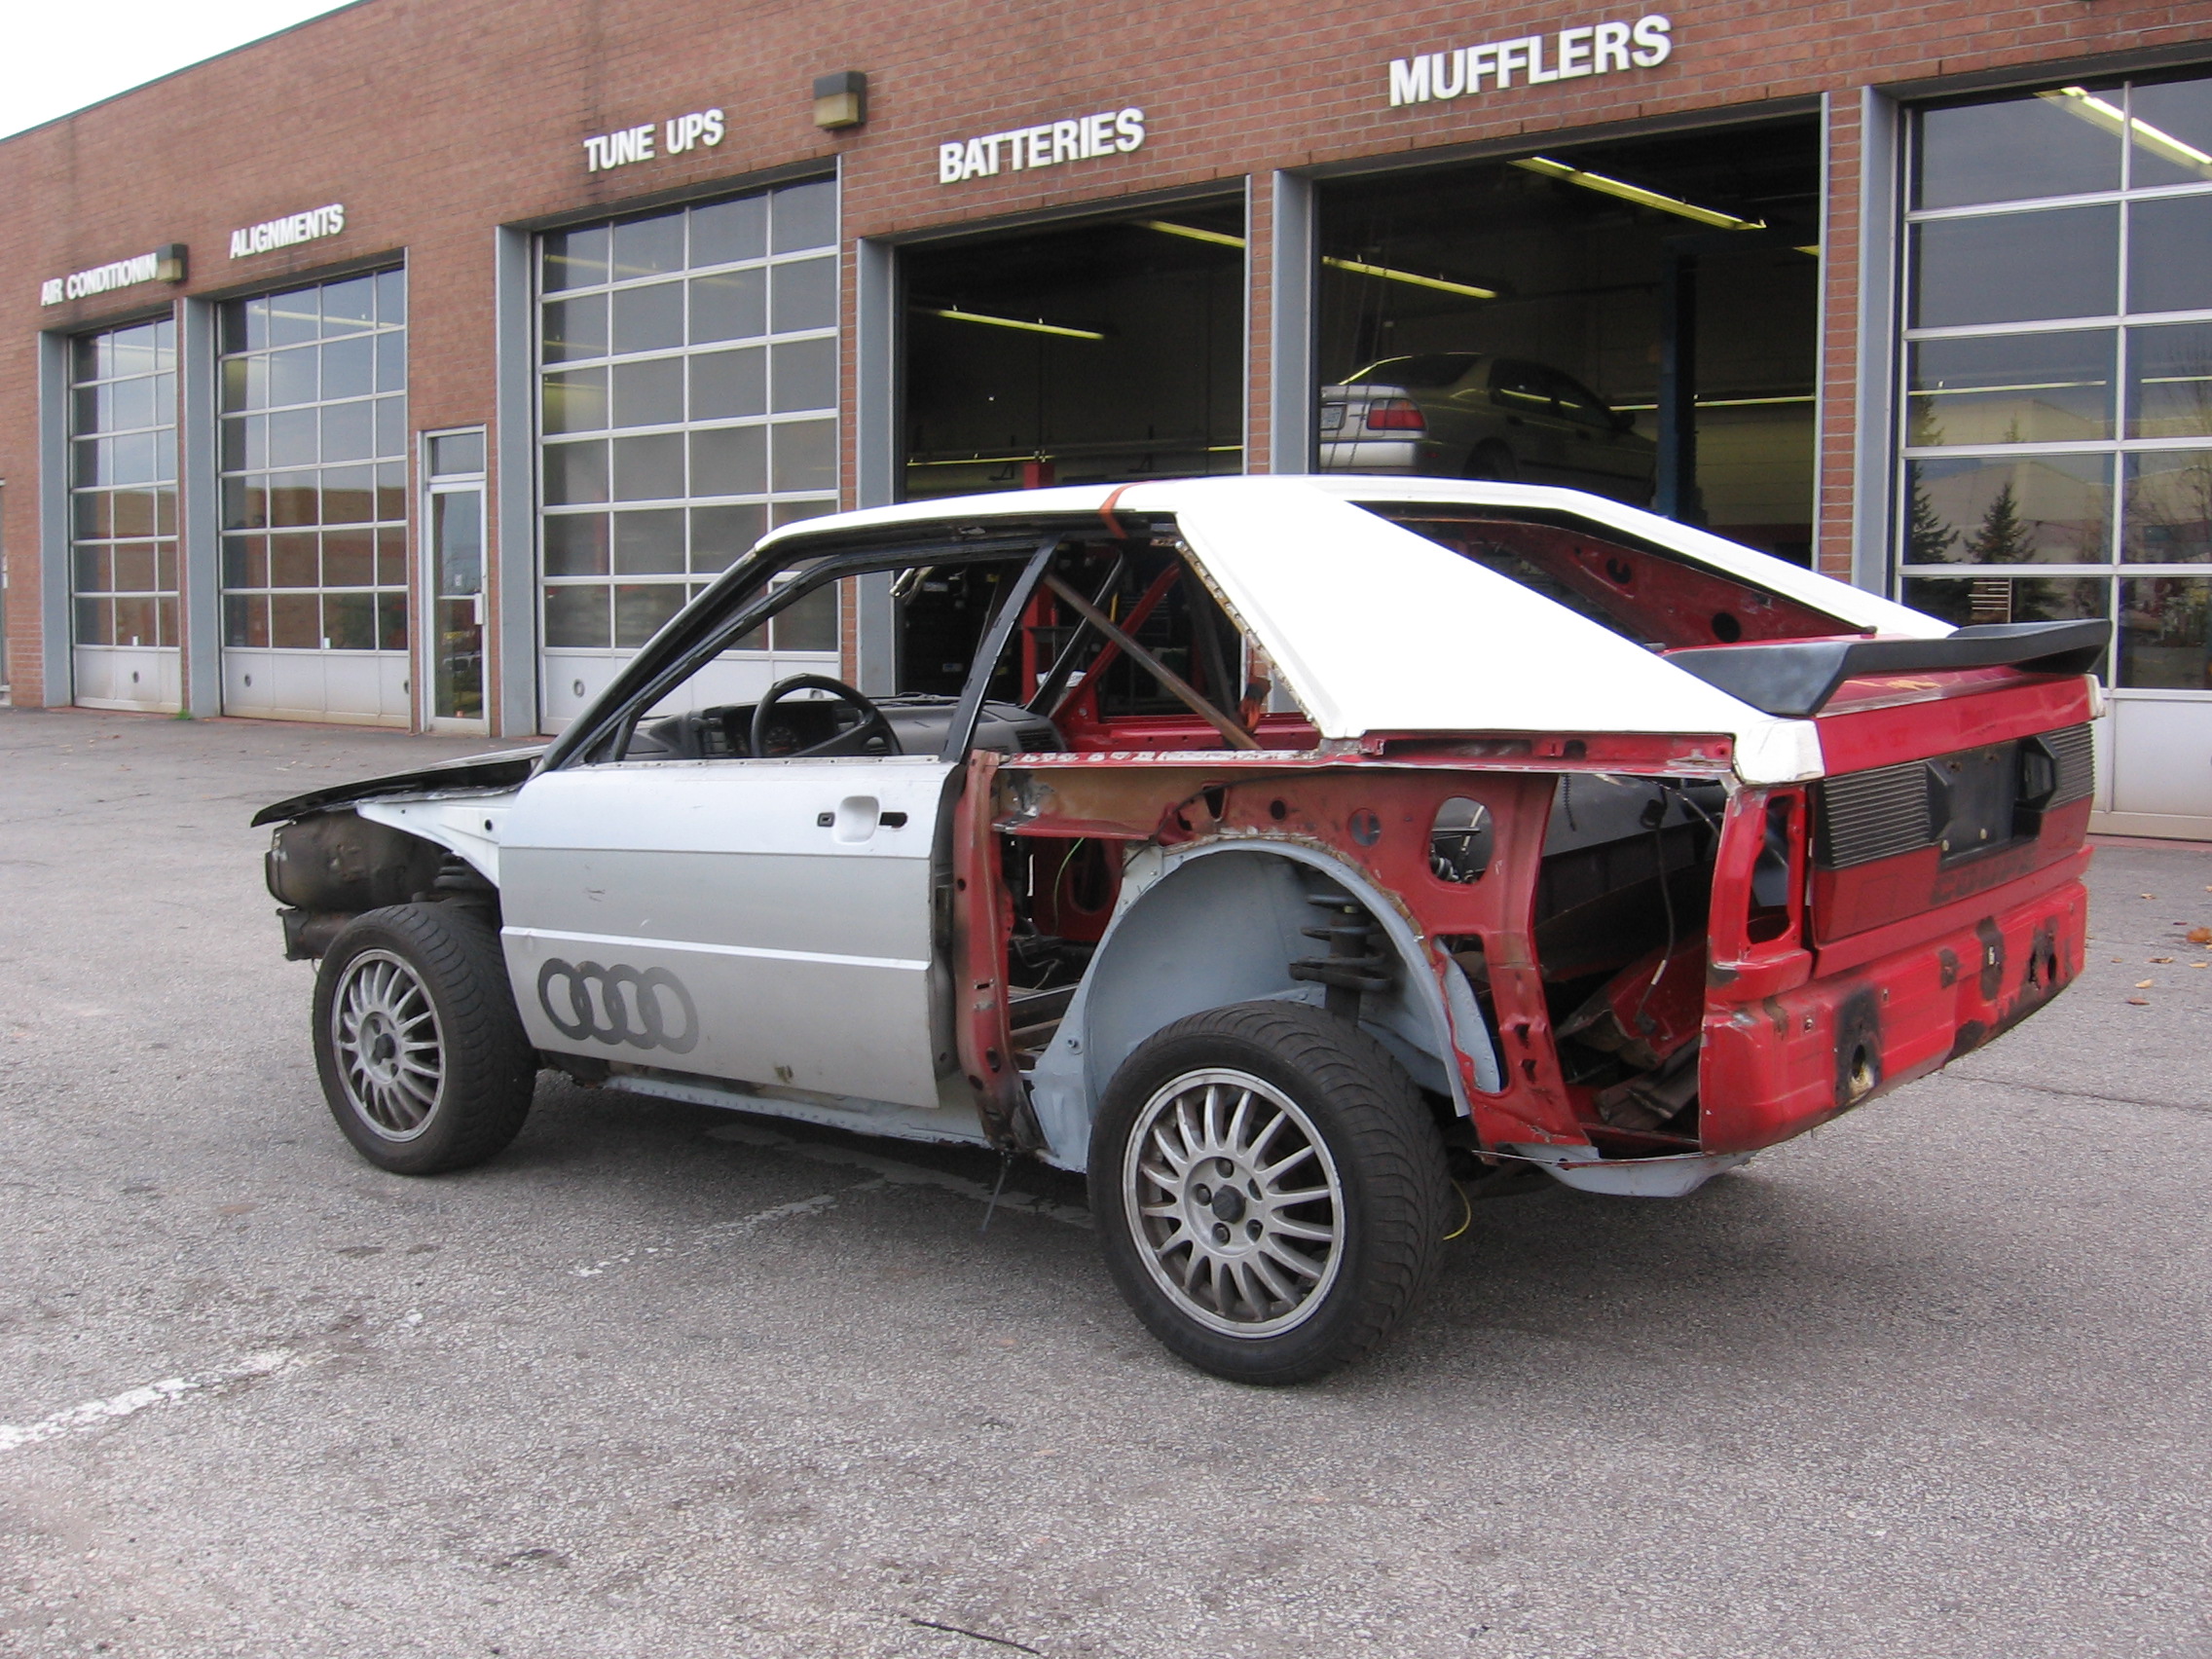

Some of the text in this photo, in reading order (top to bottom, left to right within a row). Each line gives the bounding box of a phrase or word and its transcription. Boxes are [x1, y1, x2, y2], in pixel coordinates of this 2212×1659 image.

[1389, 15, 1672, 107] MUFFLERS
[584, 108, 724, 172] TUNE UPS
[940, 107, 1145, 184] BATTERIES
[229, 203, 344, 259] ALIGNMENTS
[41, 253, 158, 307] AIR CONDITIONIN
